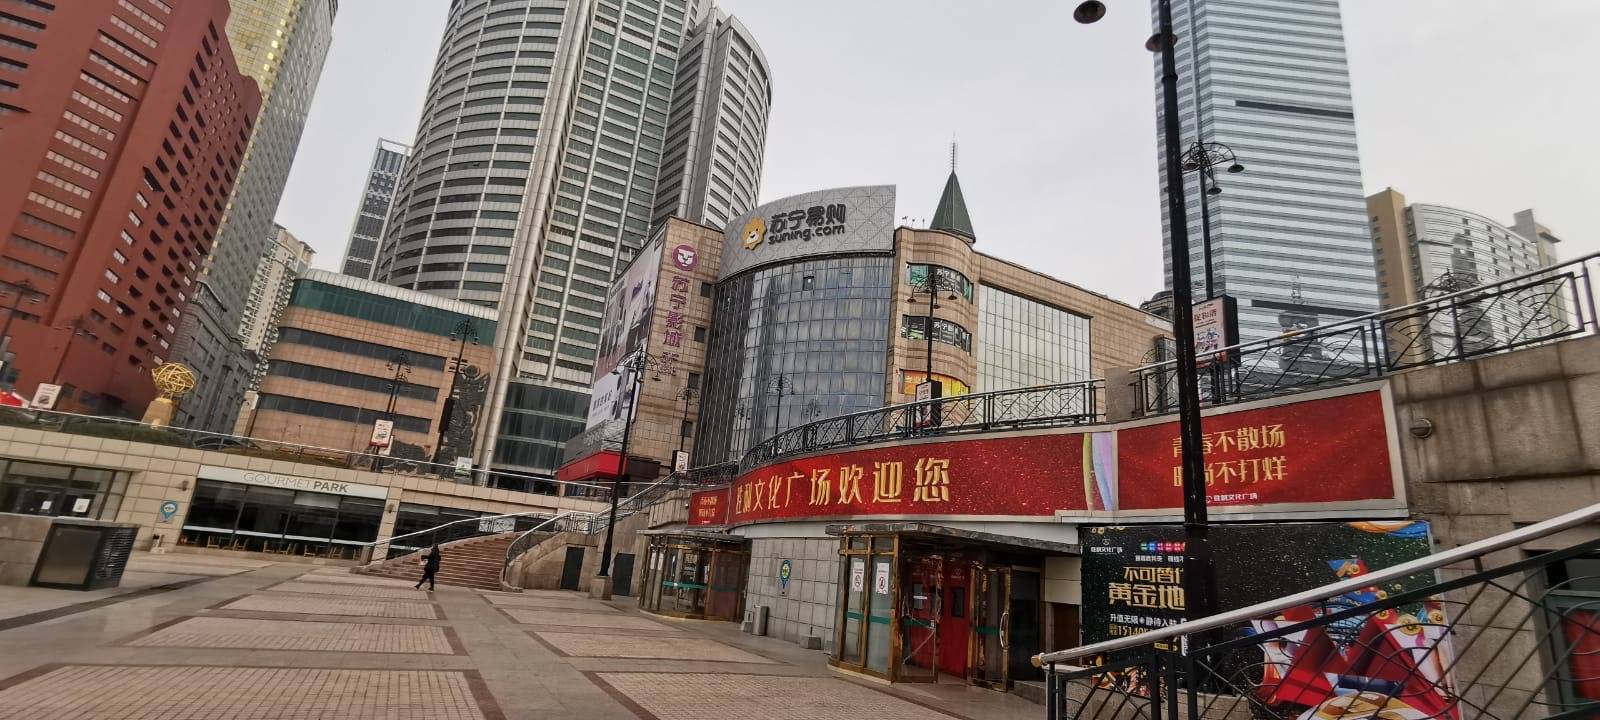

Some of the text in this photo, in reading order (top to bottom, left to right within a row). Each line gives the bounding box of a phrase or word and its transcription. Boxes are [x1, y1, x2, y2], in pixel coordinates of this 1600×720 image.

[768, 203, 847, 234] 苏宁易购
[768, 225, 846, 245] suning.com
[243, 472, 350, 494] GOURMET PARK
[735, 456, 950, 516] 胜利文化广场欢迎您
